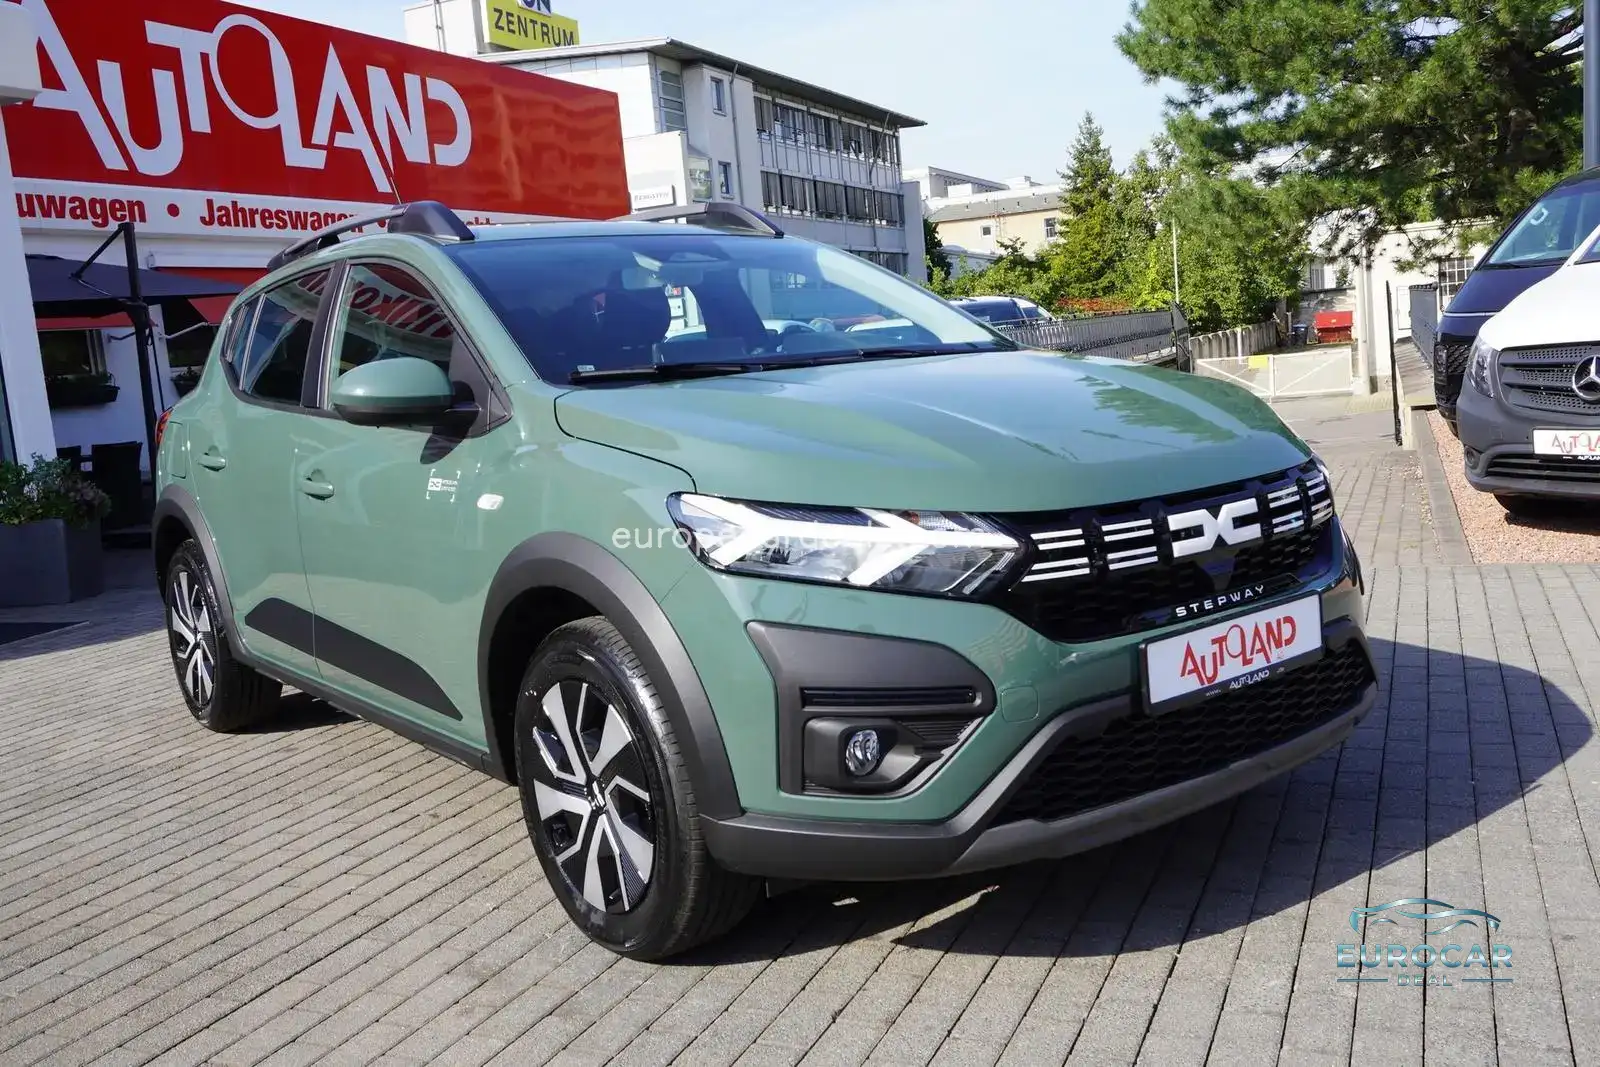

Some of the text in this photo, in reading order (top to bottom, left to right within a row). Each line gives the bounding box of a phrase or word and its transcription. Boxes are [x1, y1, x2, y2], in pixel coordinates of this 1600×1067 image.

[493, 8, 575, 47] ZENTRUM
[1175, 584, 1265, 617] STEPWAY
[1180, 615, 1297, 686] AUTOLAND
[1229, 669, 1270, 690] AUTOLAND
